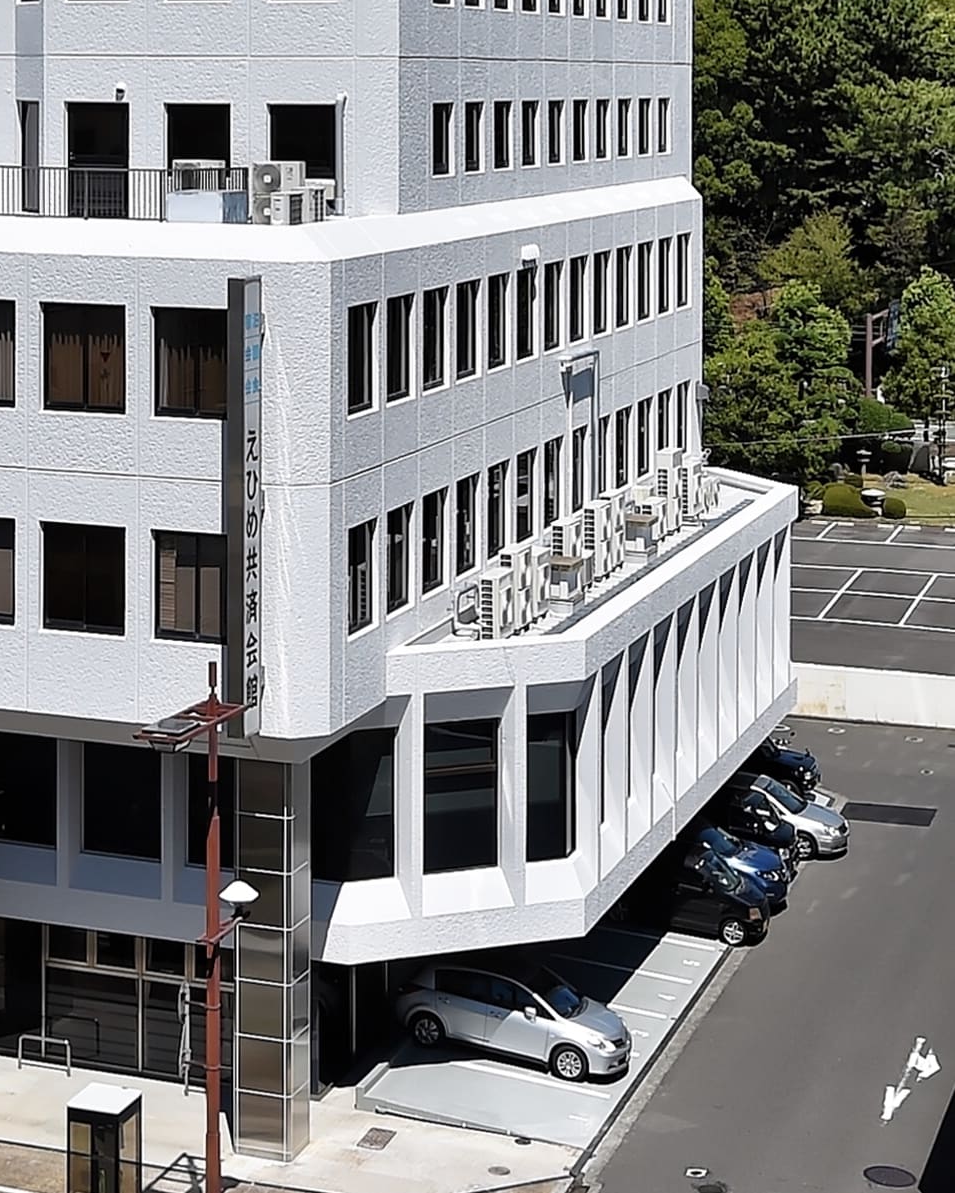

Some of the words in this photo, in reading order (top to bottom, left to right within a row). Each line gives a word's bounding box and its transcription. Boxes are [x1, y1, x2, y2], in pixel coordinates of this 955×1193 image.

[246, 429, 259, 710] えひめ共済会館
